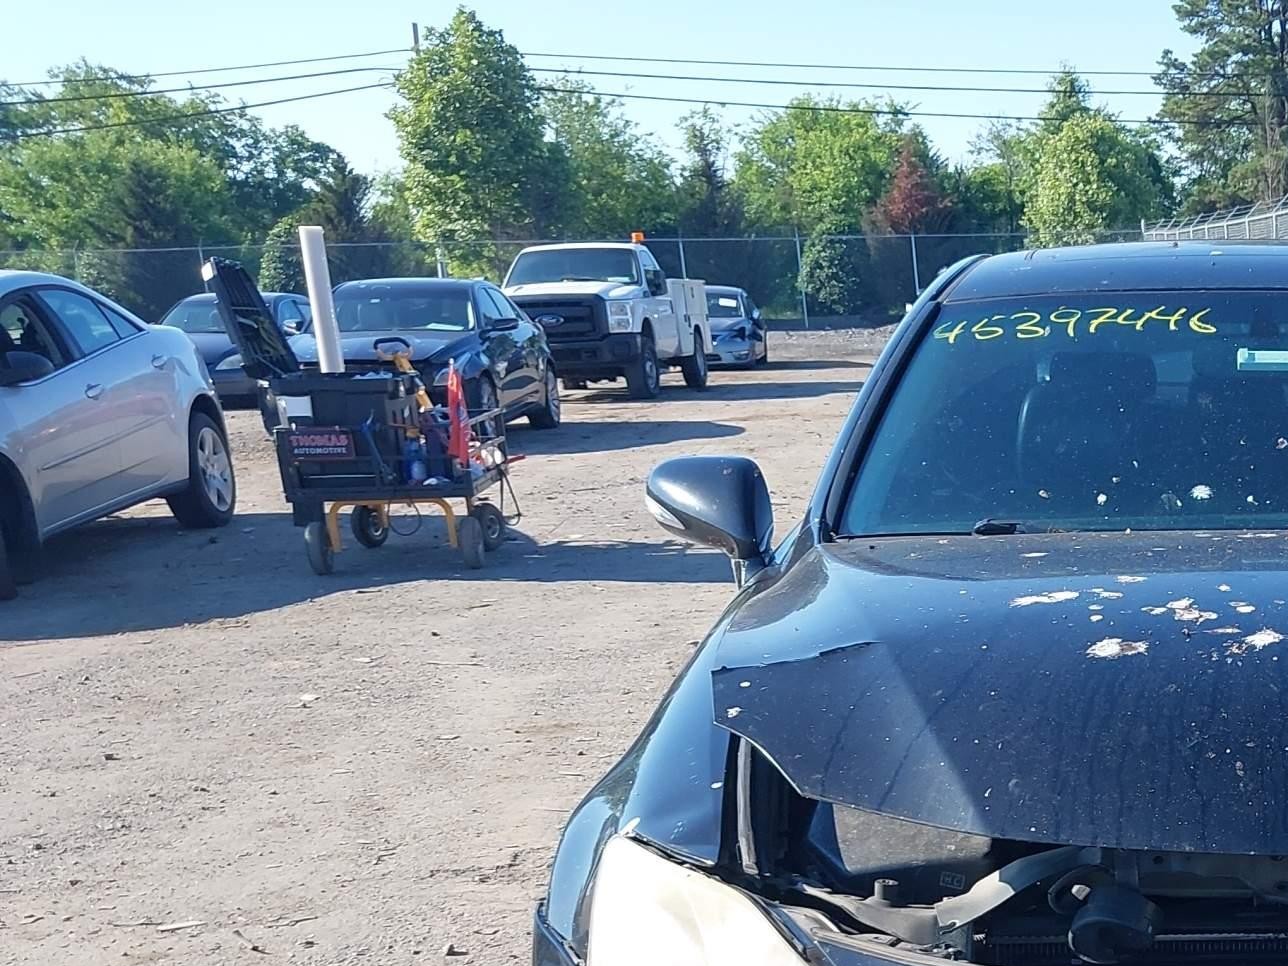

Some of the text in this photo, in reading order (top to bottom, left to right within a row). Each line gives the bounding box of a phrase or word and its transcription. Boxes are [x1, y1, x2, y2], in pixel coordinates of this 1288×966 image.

[933, 305, 1218, 344] 45397446
[289, 434, 349, 447] THOMAS
[293, 447, 348, 455] AUTOMOTIVE
